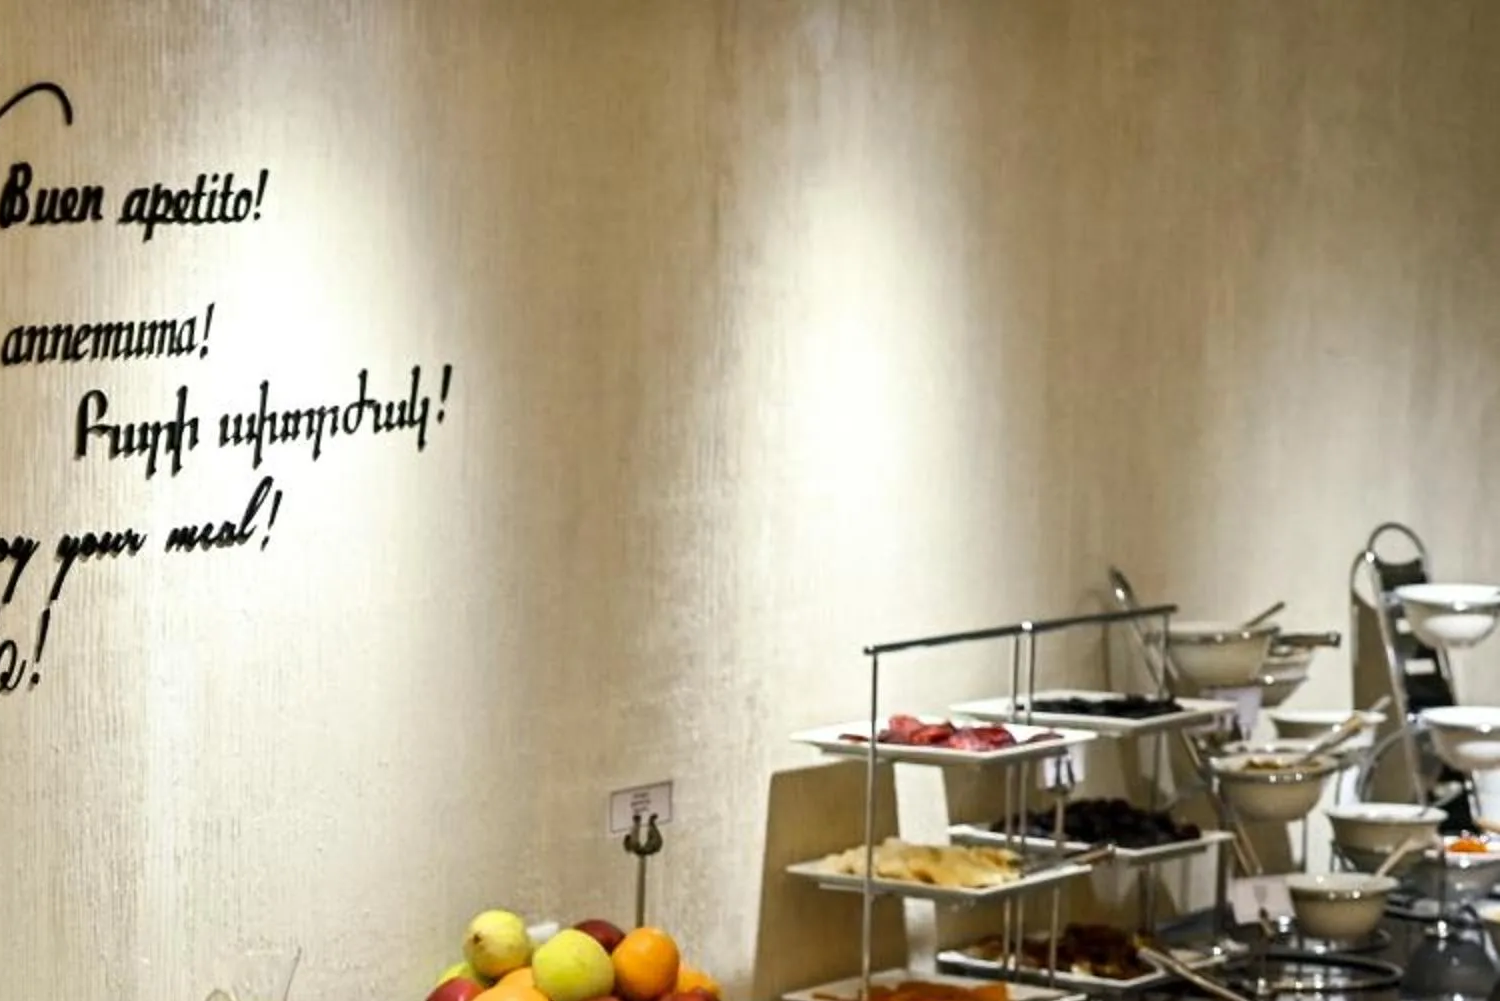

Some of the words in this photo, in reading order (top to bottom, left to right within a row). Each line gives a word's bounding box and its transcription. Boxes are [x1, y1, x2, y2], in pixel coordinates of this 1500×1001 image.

[118, 169, 269, 242] apetito!
[0, 303, 215, 367] аппетита!
[48, 528, 148, 605] your
[163, 476, 283, 552] meal!
